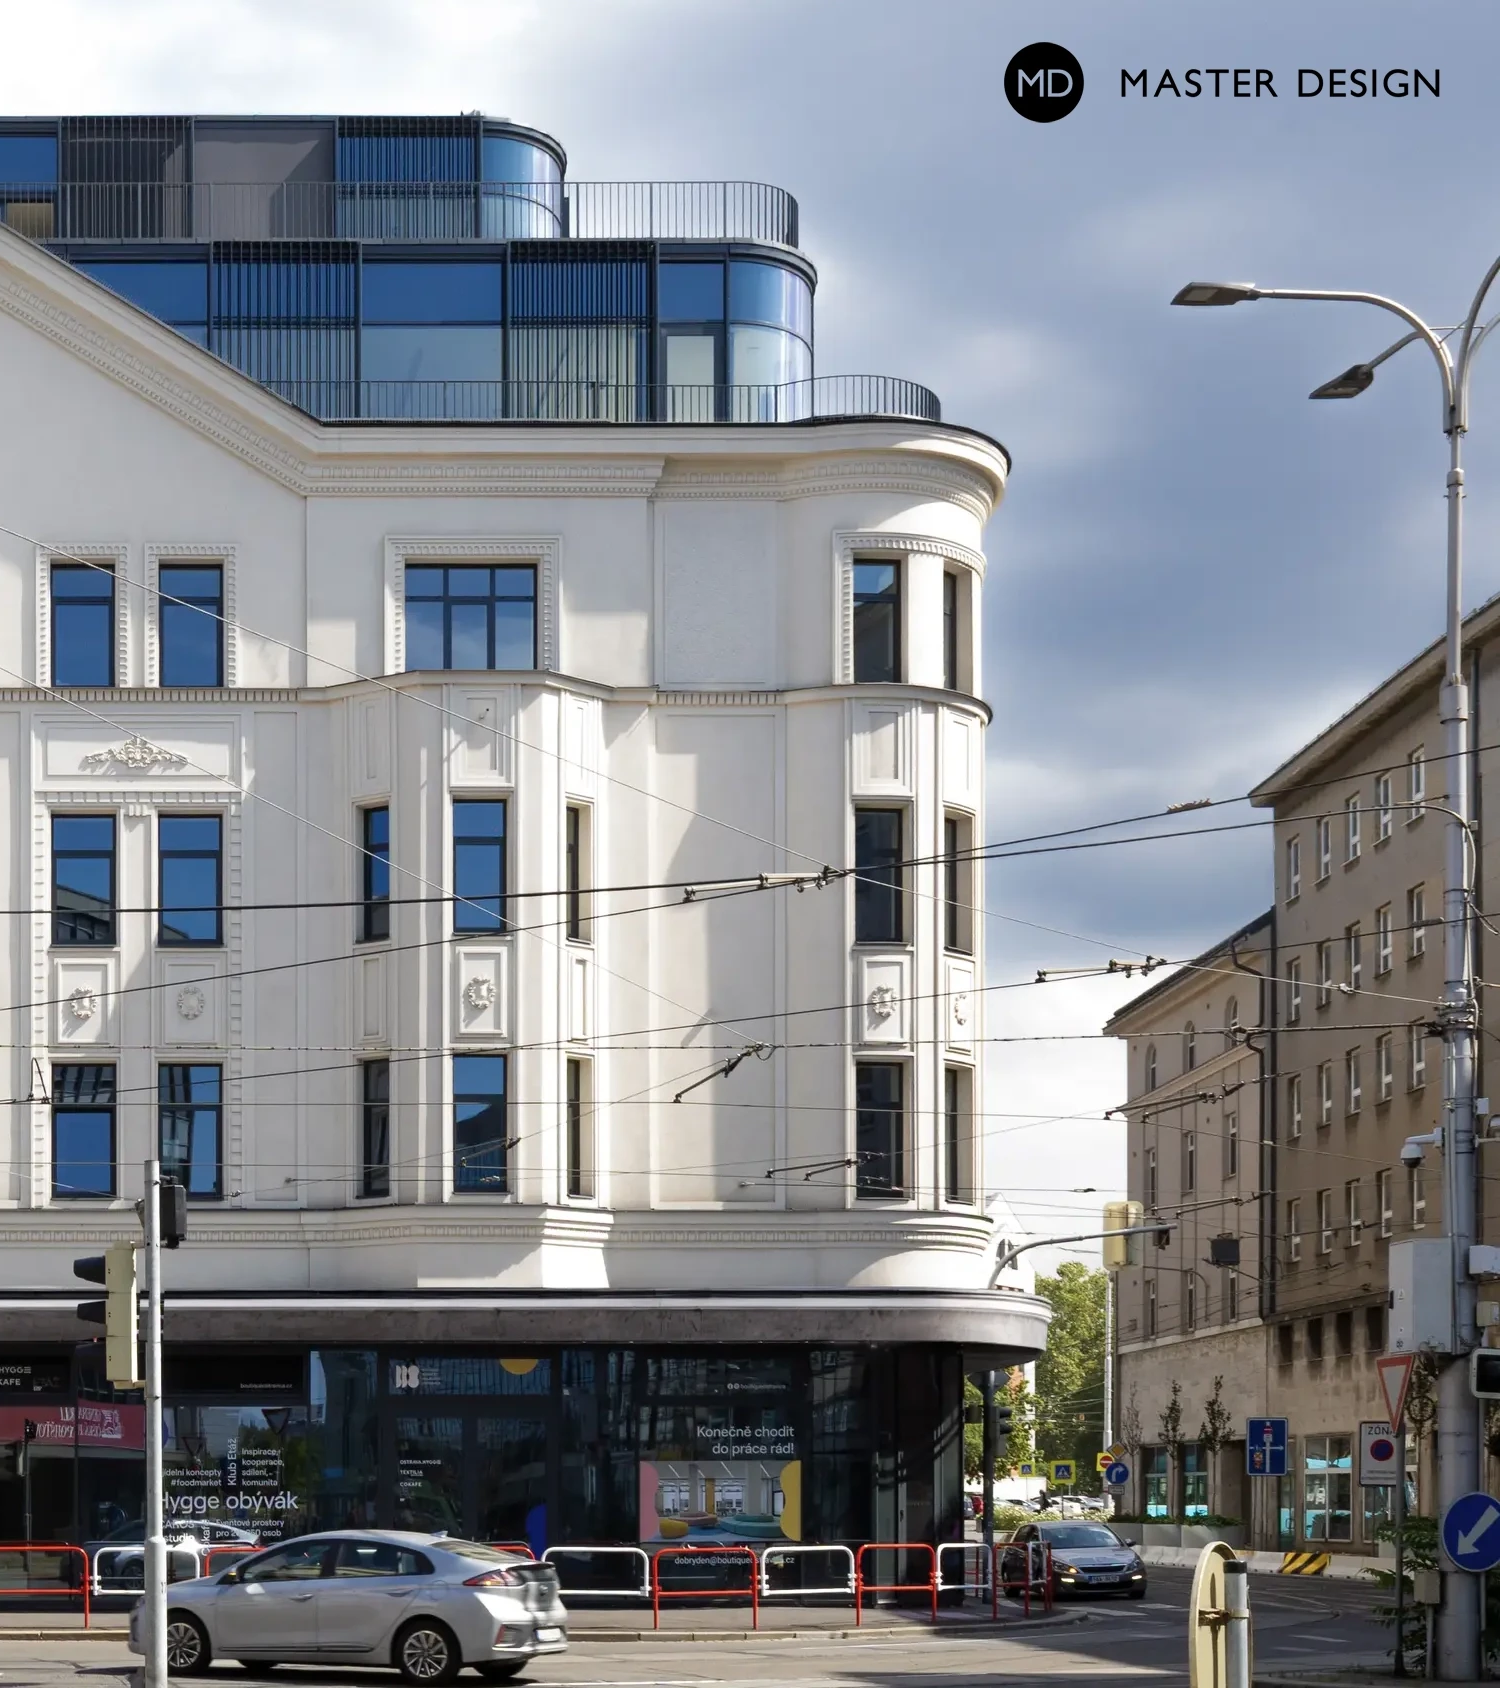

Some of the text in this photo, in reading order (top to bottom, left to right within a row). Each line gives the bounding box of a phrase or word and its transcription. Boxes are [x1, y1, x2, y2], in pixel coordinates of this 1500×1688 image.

[696, 1426, 795, 1437] Konečně chodit
[712, 1443, 795, 1457] do práce rád!
[186, 1469, 222, 1478] koncepty
[227, 1462, 236, 1486] Klub
[171, 1479, 222, 1487] #foodmarket
[242, 1479, 278, 1487] komunita
[226, 1491, 299, 1514] obývák
[252, 1519, 285, 1528] prostory
[216, 1530, 230, 1539] pro
[262, 1529, 282, 1537] osob
